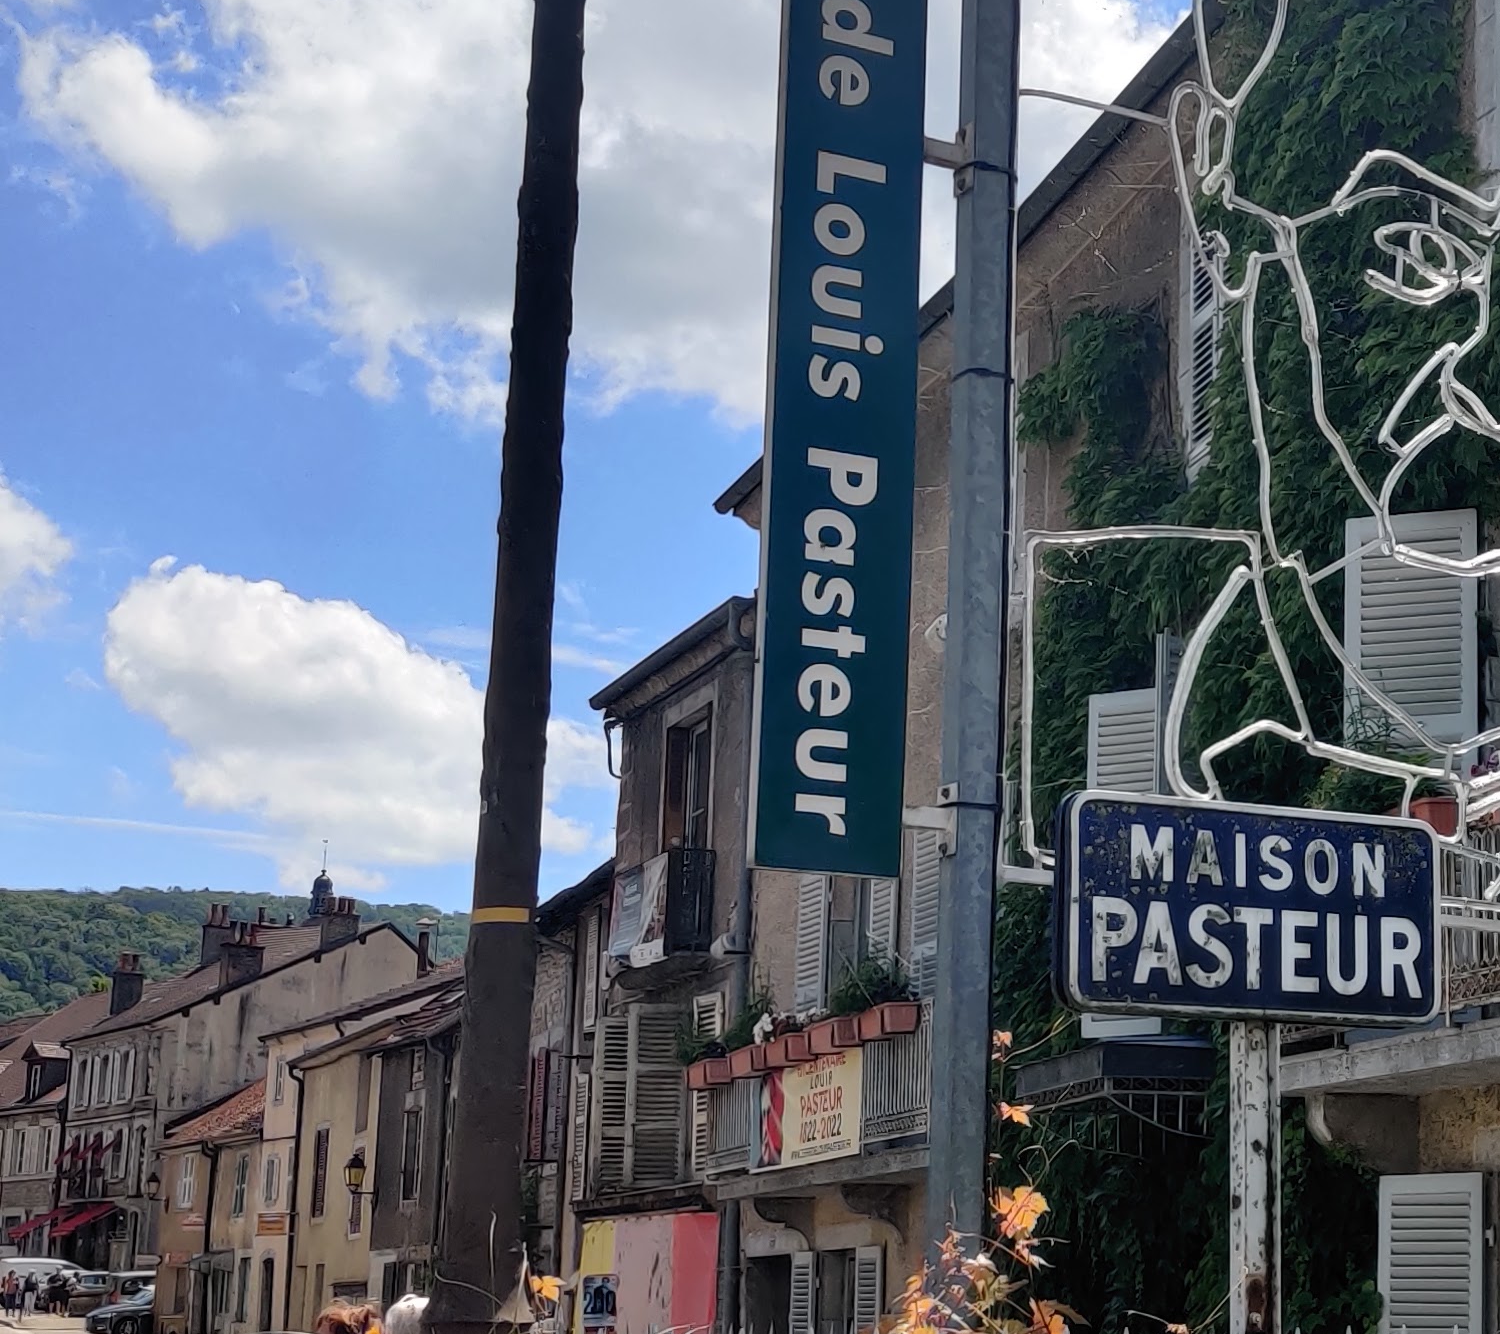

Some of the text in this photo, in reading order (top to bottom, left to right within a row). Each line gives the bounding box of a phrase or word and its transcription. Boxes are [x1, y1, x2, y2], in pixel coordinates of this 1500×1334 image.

[807, 148, 887, 403] Louis
[794, 446, 879, 838] Pasteur
[1128, 823, 1386, 899] MAISON
[1091, 895, 1424, 1000] PASTEUR
[800, 1085, 843, 1118] PASTEUR
[800, 1112, 842, 1144] 1822-2022
